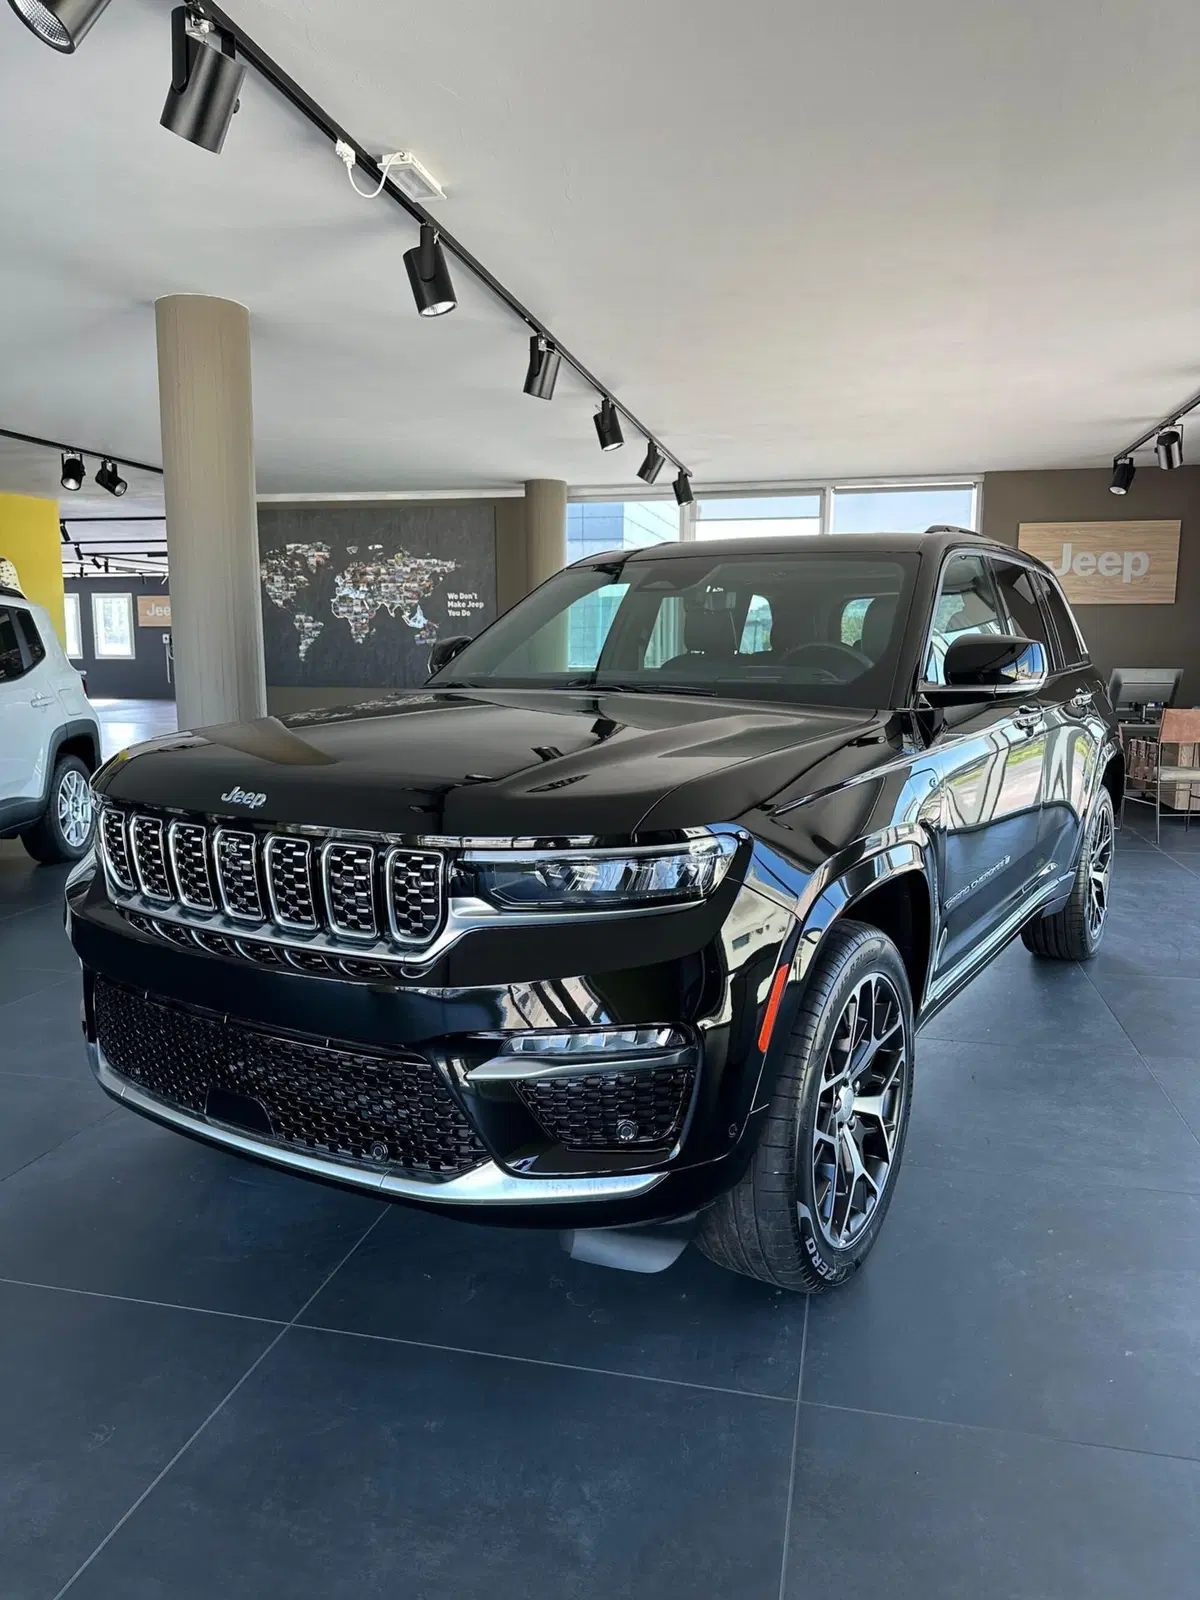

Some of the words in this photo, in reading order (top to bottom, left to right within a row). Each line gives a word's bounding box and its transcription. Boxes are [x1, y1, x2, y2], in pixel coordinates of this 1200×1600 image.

[1042, 543, 1150, 583] Jeep
[447, 592, 458, 600] We
[460, 592, 478, 600] Don't
[146, 603, 171, 617] Jee
[467, 601, 484, 609] Jeep
[221, 786, 267, 809] Jeep
